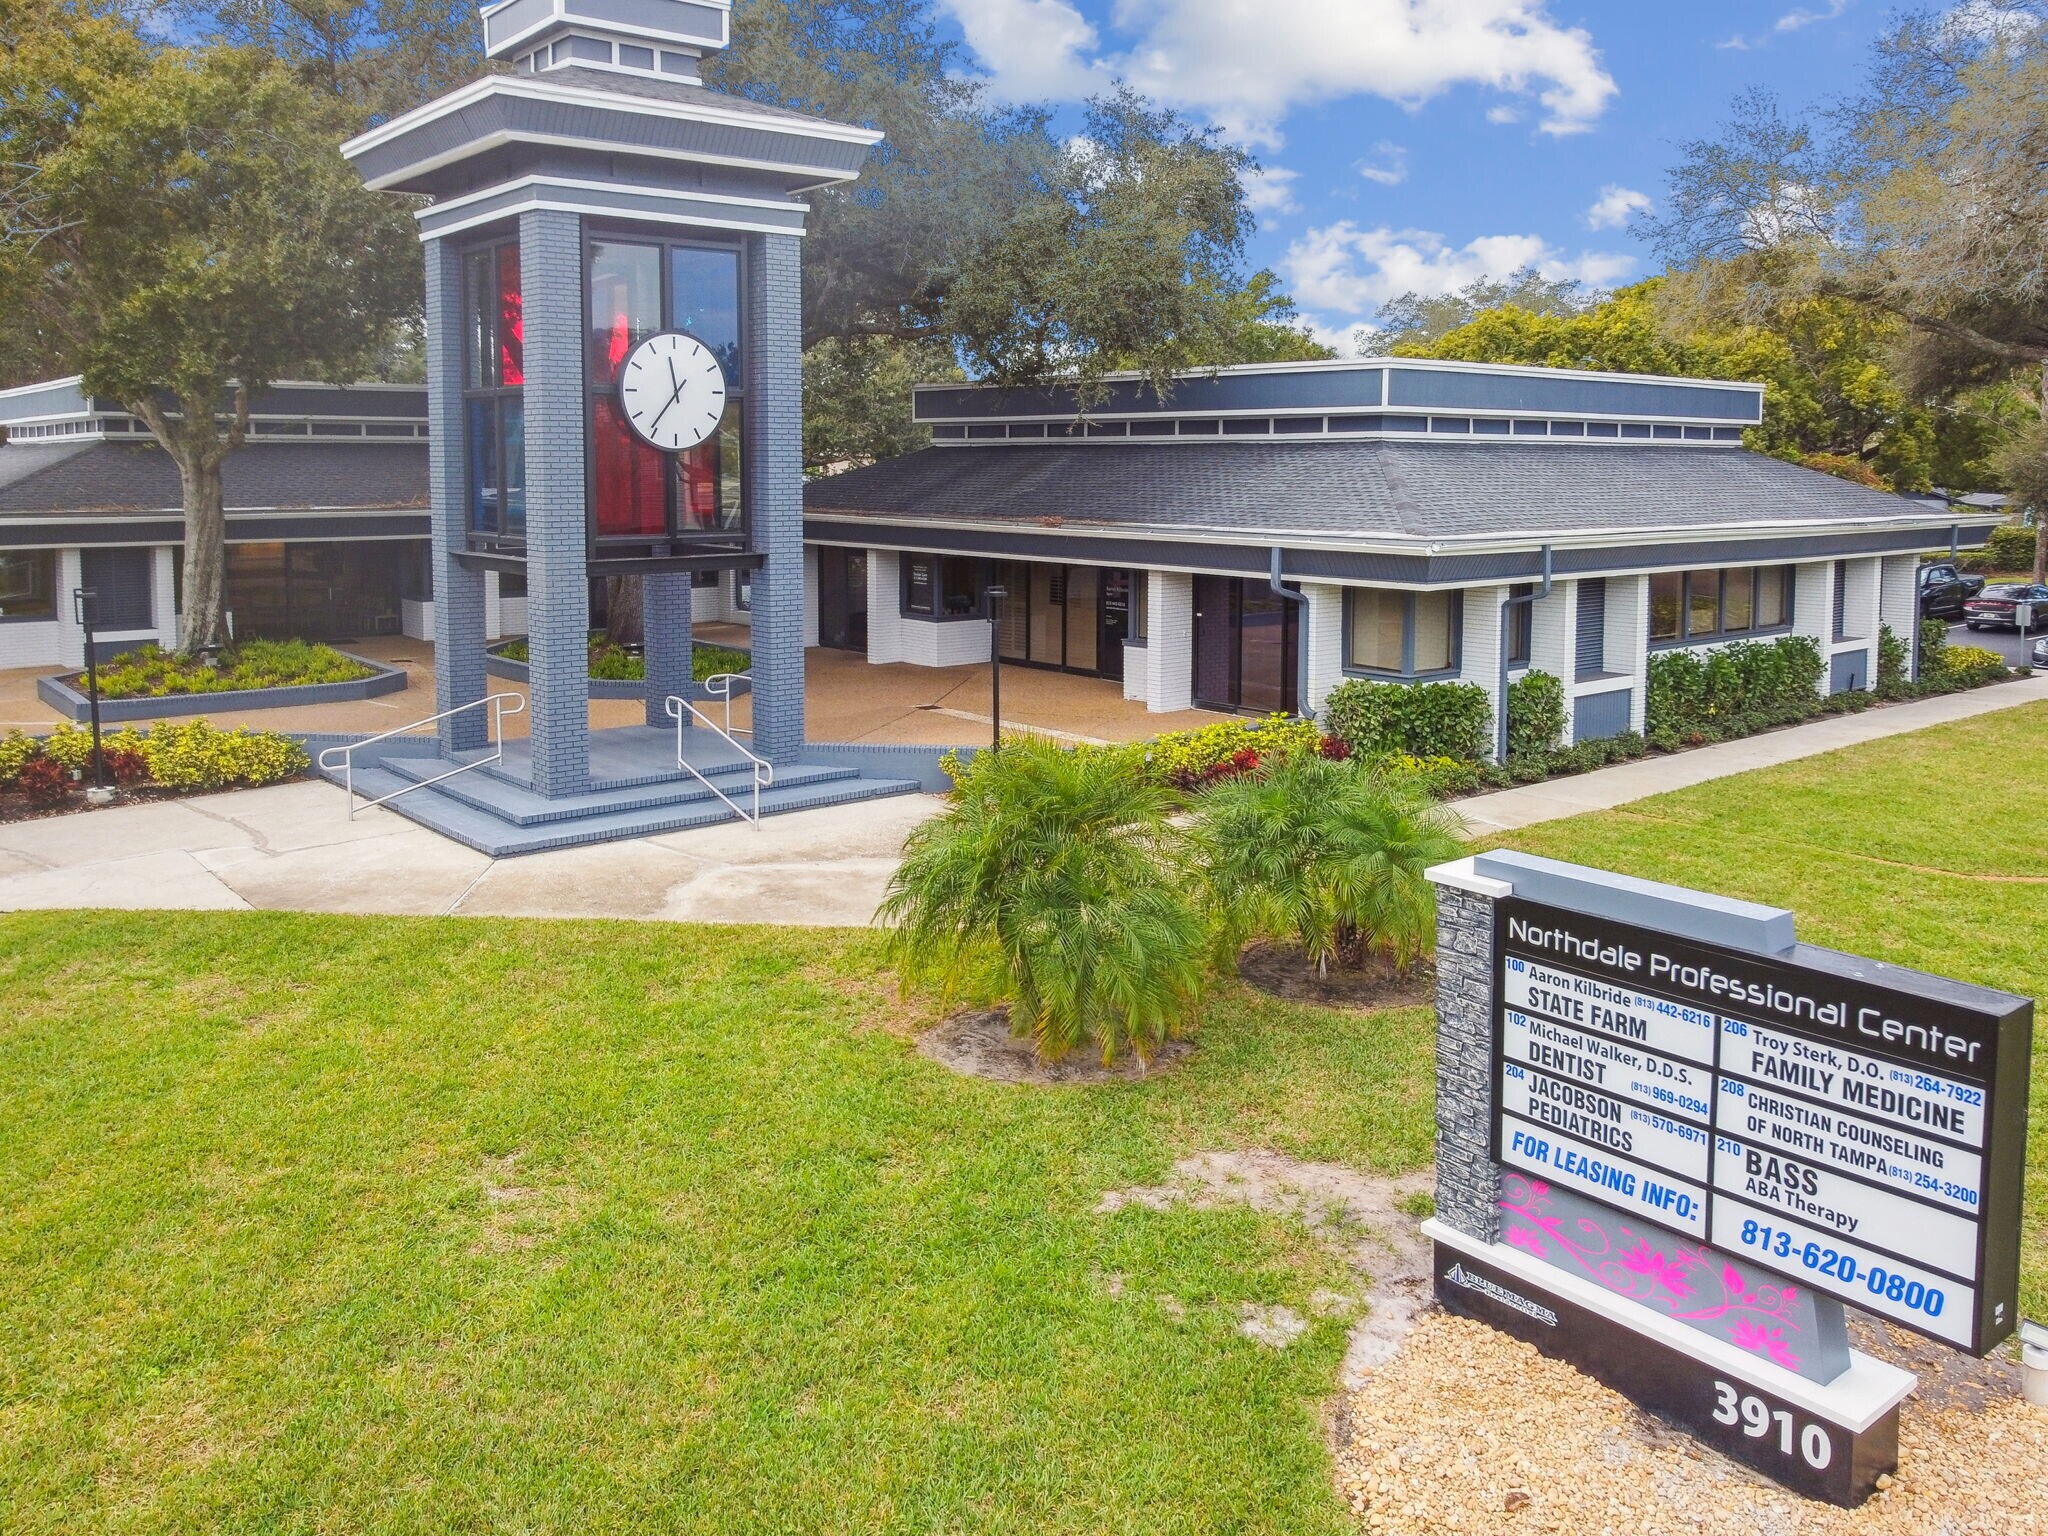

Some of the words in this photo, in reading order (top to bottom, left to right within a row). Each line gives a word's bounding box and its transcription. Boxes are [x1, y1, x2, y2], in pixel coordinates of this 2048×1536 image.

[1506, 958, 1525, 973] 100
[1529, 966, 1570, 990] Aaron
[1574, 979, 1631, 1008] Kilbride
[1634, 997, 1655, 1012] (813)
[1656, 1002, 1711, 1028] 442-6216
[1509, 917, 1642, 971] Northdale
[1650, 953, 1847, 1028] Professional
[1858, 1008, 1981, 1062] Center
[1528, 986, 1584, 1022] STATE
[1591, 1004, 1647, 1041] FARM
[1507, 1012, 1526, 1027] 102
[1530, 1021, 1583, 1049] Michael
[1587, 1039, 1642, 1071] Walker,
[1647, 1057, 1693, 1085] D.D.S.
[1529, 1040, 1606, 1084] DENTIST
[1724, 1020, 1747, 1037] 206
[1753, 1030, 1789, 1055] Troy
[1793, 1042, 1842, 1069] Sterk,
[1848, 1057, 1884, 1080] D.O.
[1890, 1069, 1913, 1087] (813)
[1915, 1075, 1982, 1107] 264-7922
[1505, 1065, 1525, 1080] 204
[1529, 1074, 1622, 1124] JACOBSON
[1529, 1097, 1633, 1152] PEDIATRICS
[1630, 1110, 1651, 1126] (813)
[1652, 1116, 1707, 1146] 570-6971
[1631, 1081, 1652, 1097] (813)
[1652, 1087, 1708, 1115] 969-0294
[1721, 1079, 1745, 1097] 208
[1748, 1093, 1831, 1132] CHRISTIAN
[1837, 1121, 1944, 1168] COUNSELING
[1752, 1051, 1834, 1094] FAMILY
[1842, 1078, 1965, 1135] MEDICINE
[1512, 1131, 1549, 1163] FOR
[1554, 1147, 1636, 1197] LEASING
[1641, 1181, 1699, 1221] INFO:
[1717, 1138, 1741, 1157] 210
[1746, 1149, 1819, 1196] BASS
[1747, 1116, 1767, 1134] OF
[1772, 1123, 1824, 1154] NORTH
[1830, 1142, 1888, 1175] TAMPA
[1914, 1173, 1978, 1205] 254-3200
[1745, 1178, 1780, 1202] ABA
[1784, 1189, 1859, 1232] Therapy
[1740, 1219, 1945, 1317] 813-620-0800
[1712, 1380, 1832, 1470] 3910
